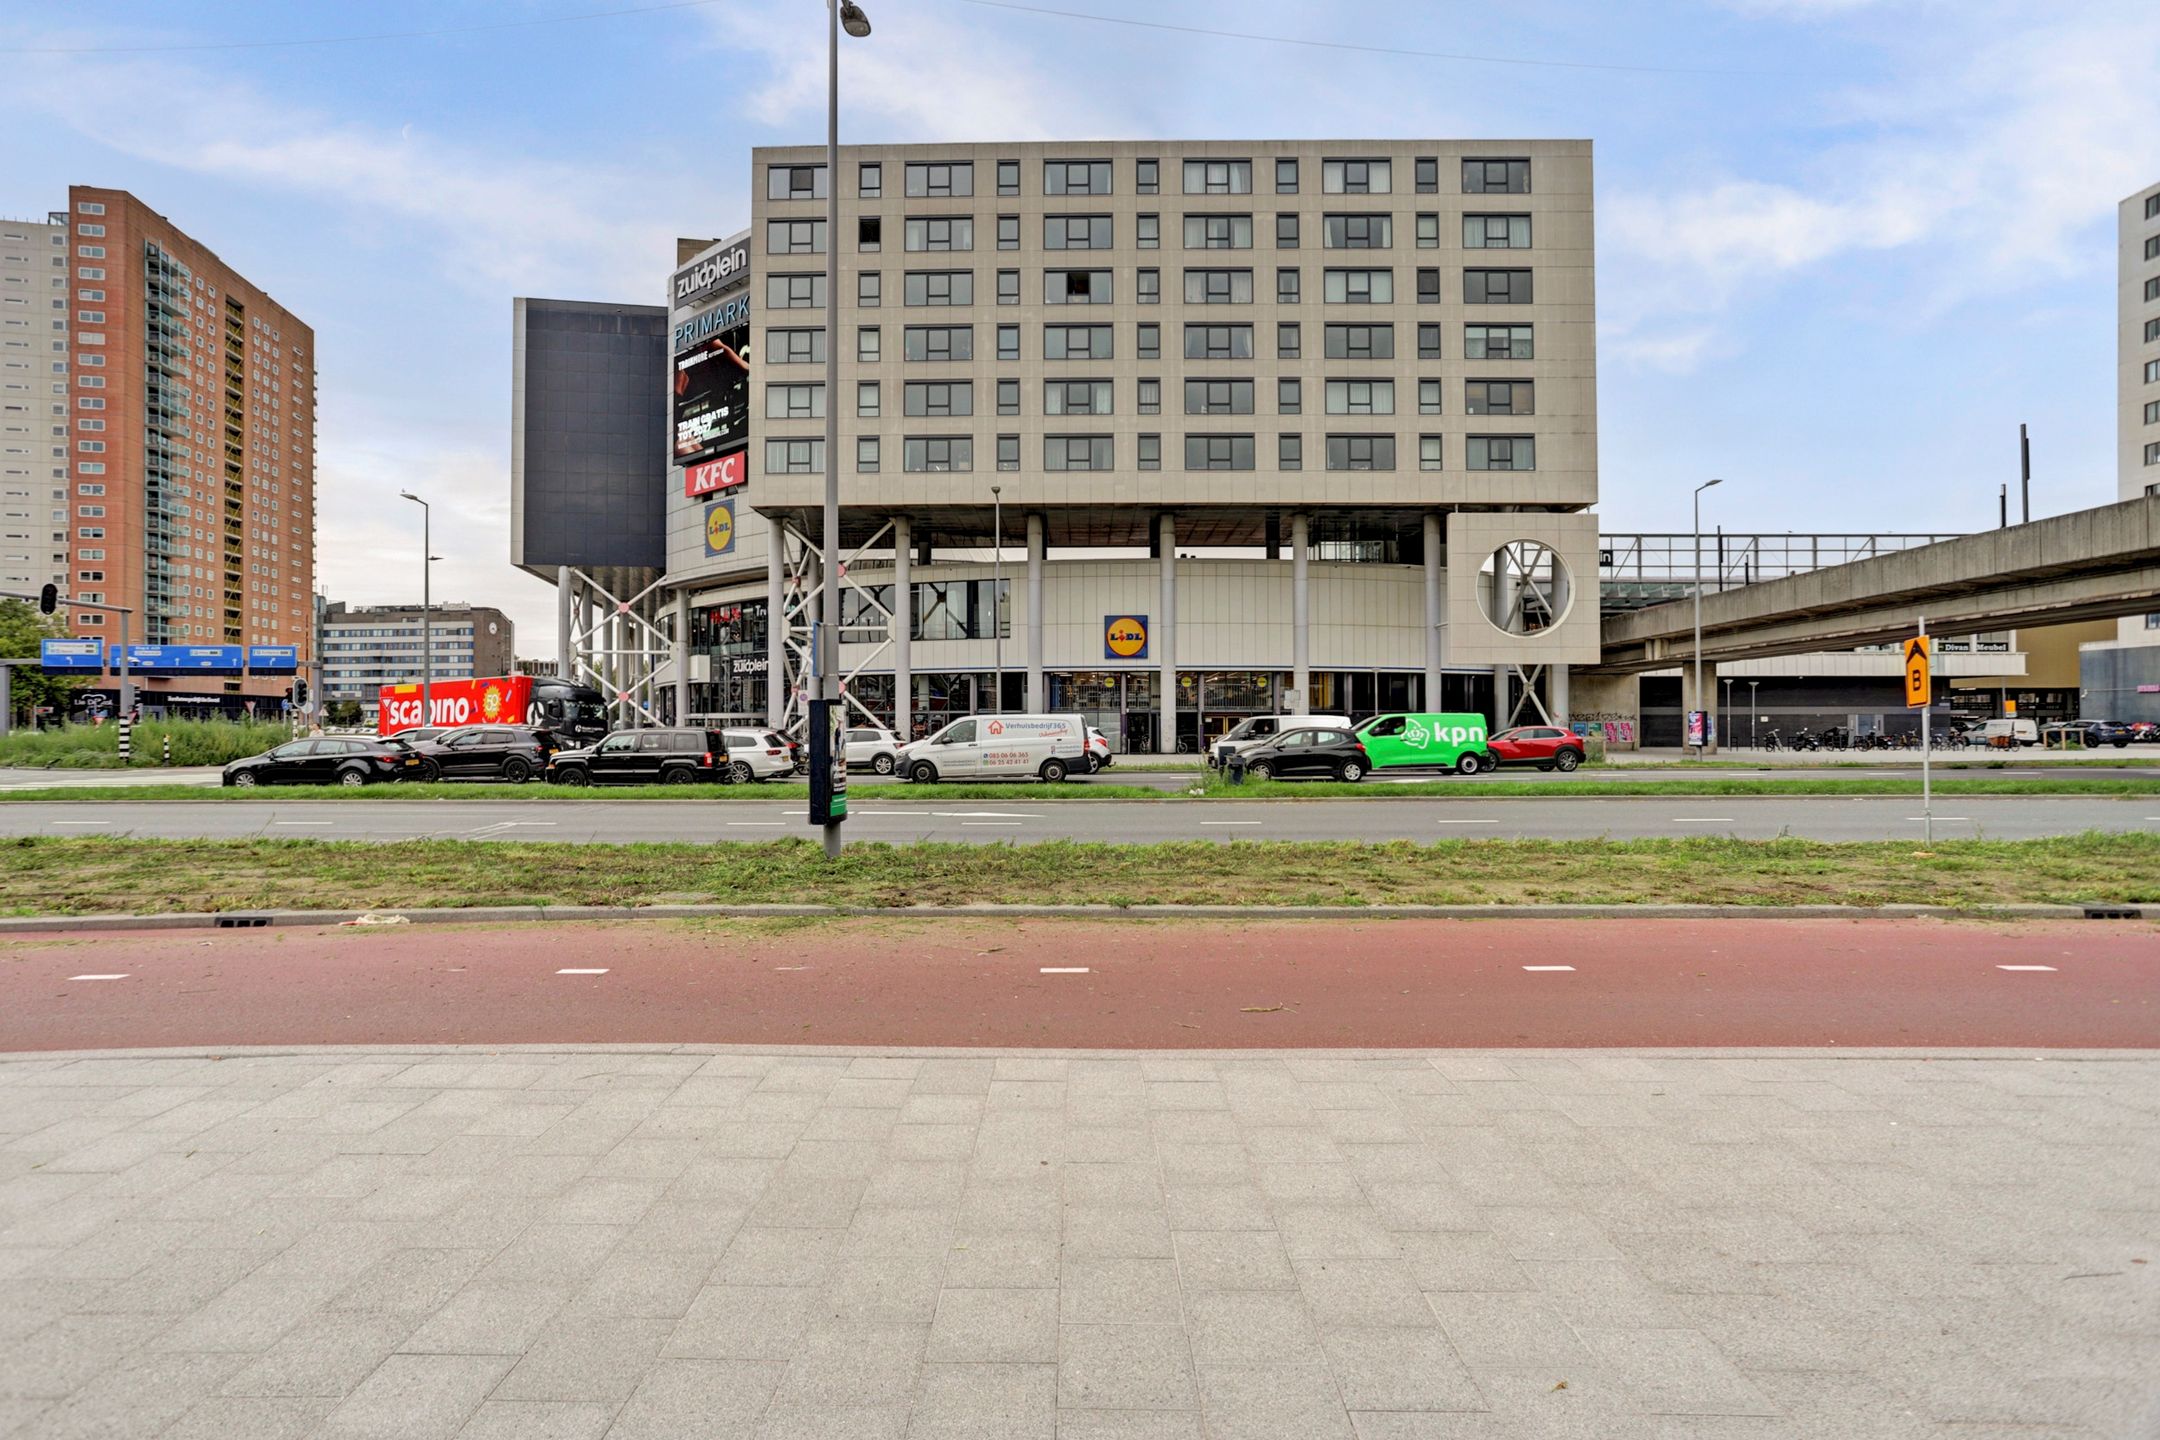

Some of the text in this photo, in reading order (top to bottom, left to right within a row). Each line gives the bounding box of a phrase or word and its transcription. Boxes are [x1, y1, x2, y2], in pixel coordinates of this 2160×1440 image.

[678, 247, 747, 298] zuidplein
[674, 295, 750, 348] PRIMARK
[701, 406, 729, 423] GRATIS
[694, 458, 735, 492] KFC
[1976, 643, 2007, 651] Meubel
[1913, 669, 1922, 691] B
[1434, 722, 1484, 747] kpn
